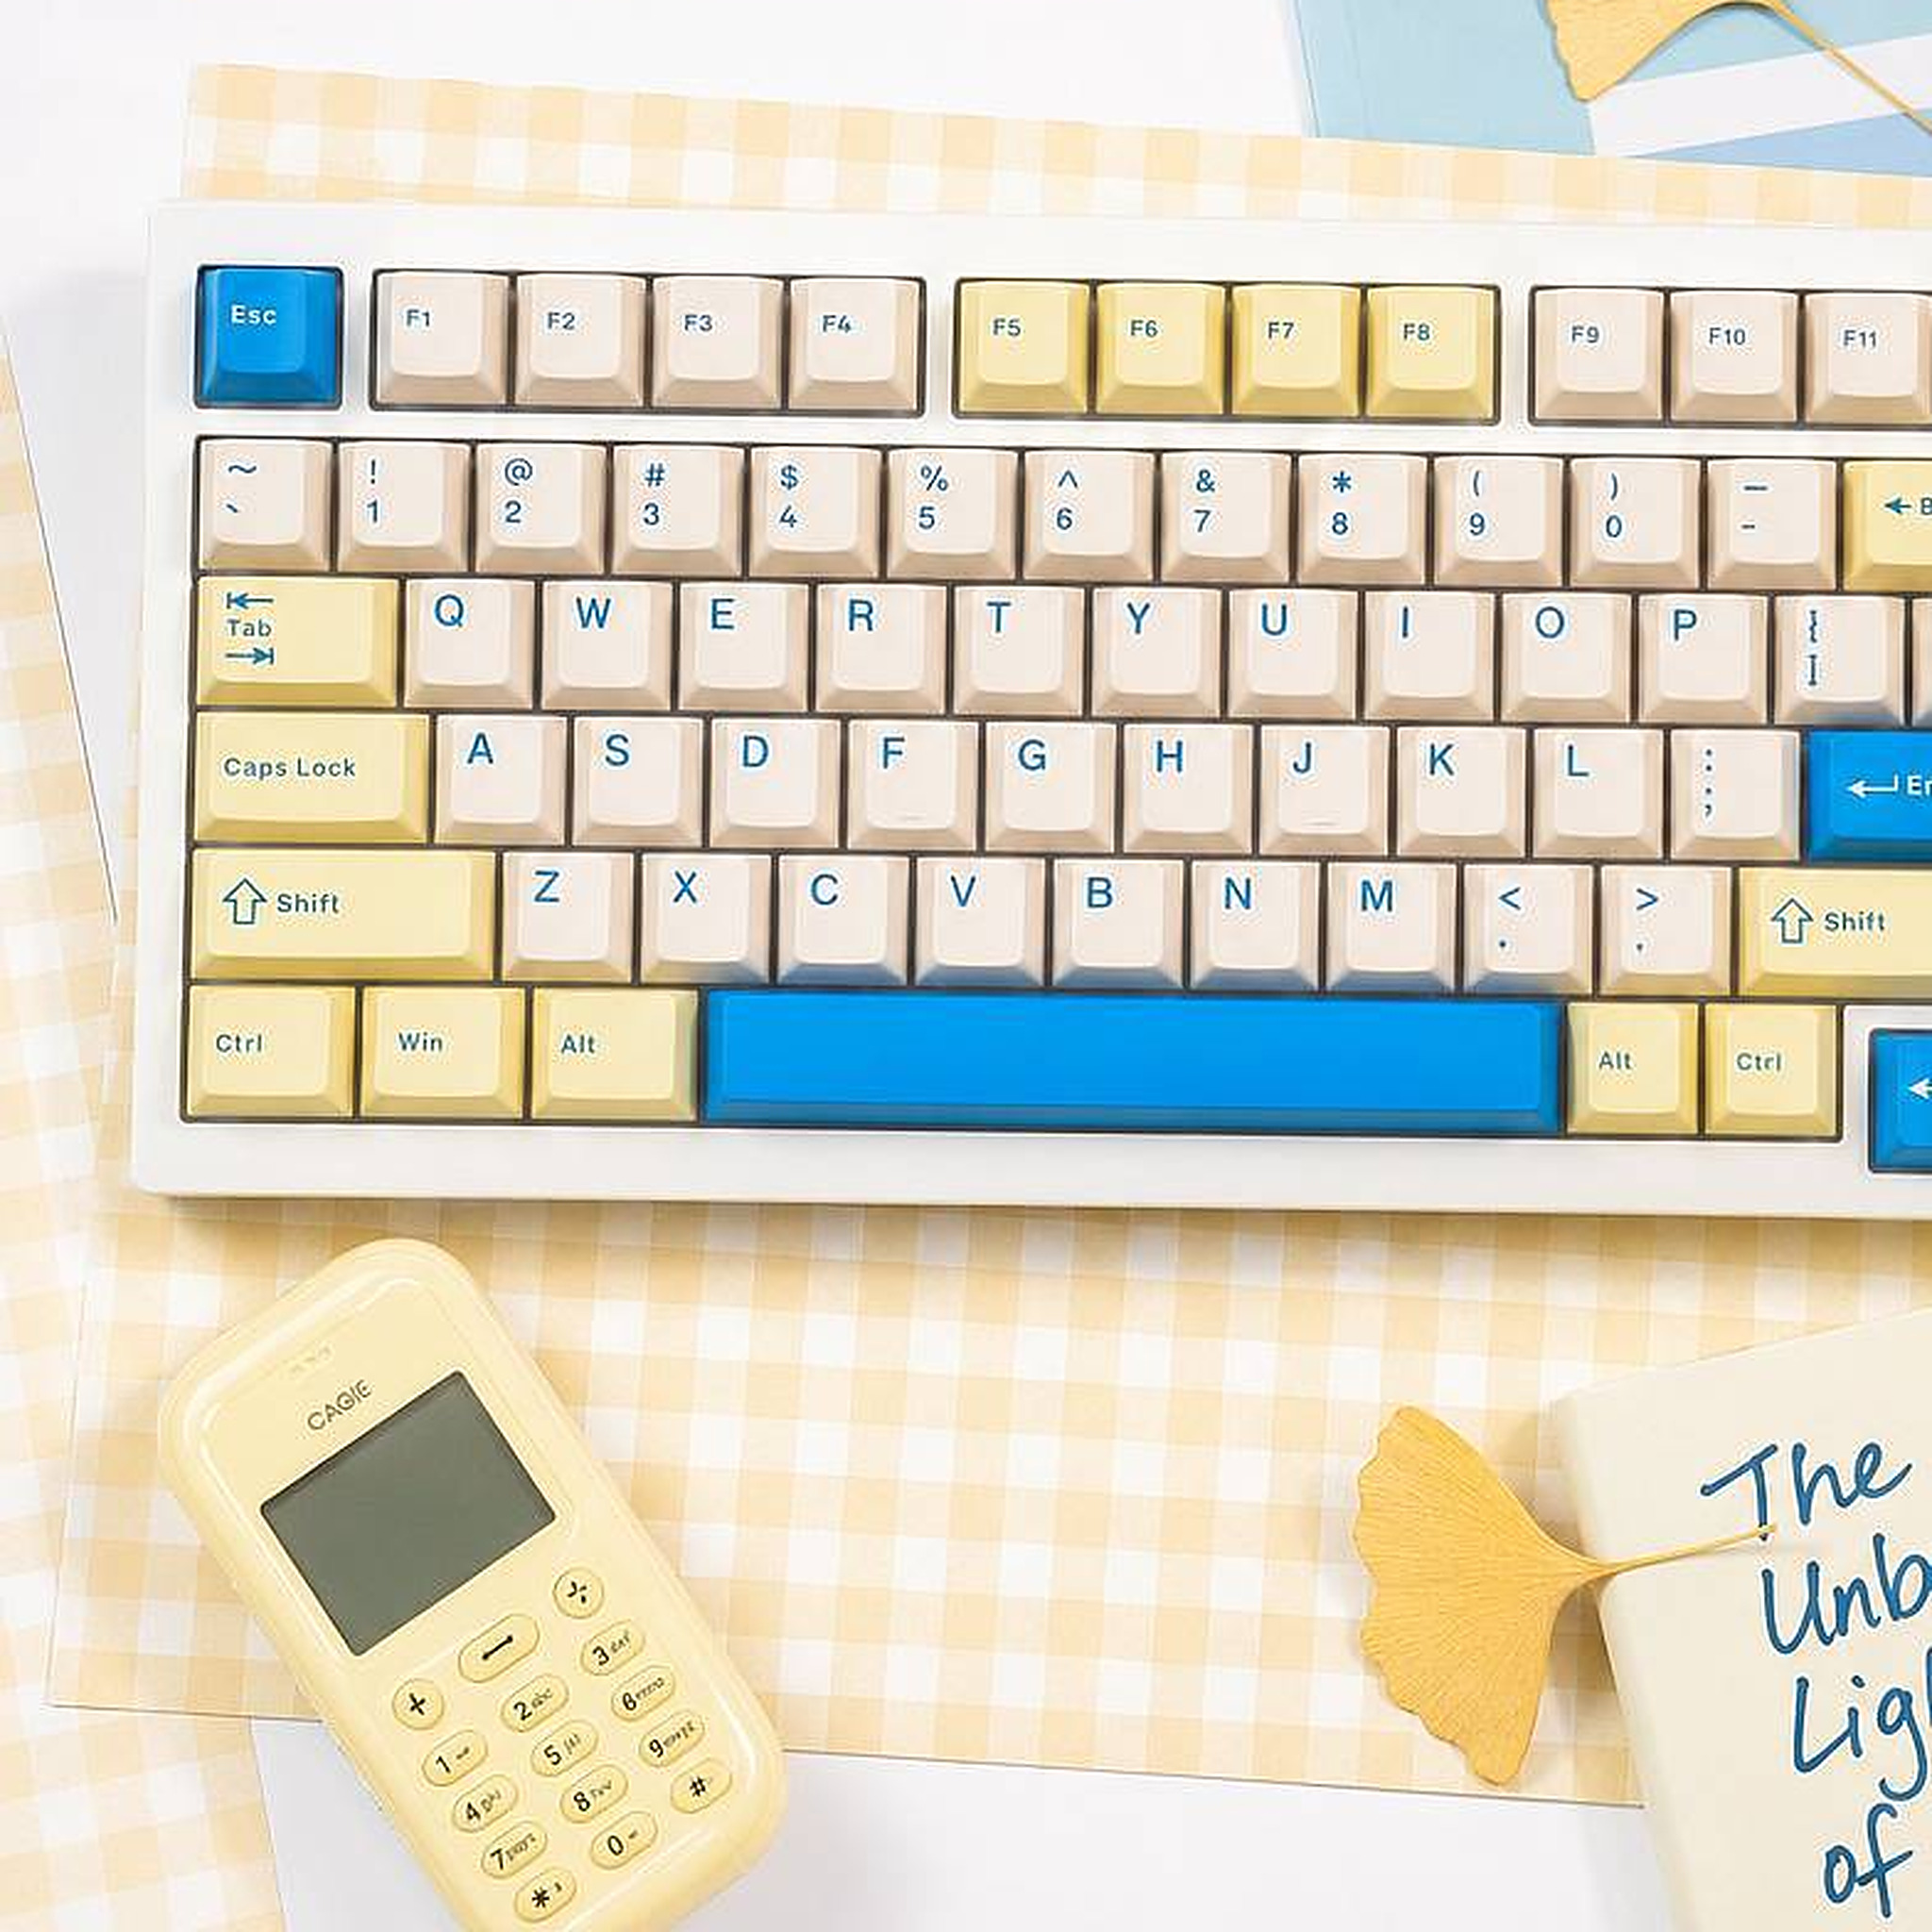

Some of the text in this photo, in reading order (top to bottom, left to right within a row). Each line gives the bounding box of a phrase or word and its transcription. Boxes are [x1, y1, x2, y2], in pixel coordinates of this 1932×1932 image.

[231, 305, 276, 325] Esc
[407, 308, 430, 327] F1
[548, 311, 575, 330] F2
[684, 314, 713, 332] F3
[823, 314, 851, 333] F4
[993, 318, 1022, 337] F5
[1130, 319, 1158, 338] F6
[1268, 321, 1294, 340] F7
[1403, 323, 1430, 341] F8
[1572, 325, 1600, 344] F9
[1708, 326, 1746, 346] F10
[1843, 329, 1876, 347] F11
[371, 459, 376, 485] !
[504, 458, 533, 487] @
[644, 463, 665, 488] #
[780, 464, 798, 491] $
[921, 465, 948, 491] %
[1196, 469, 1215, 493] &
[367, 500, 378, 523] 1
[505, 500, 522, 524] 2
[643, 503, 659, 525] 3
[779, 505, 798, 528] 4
[919, 506, 936, 530] 5
[1057, 508, 1073, 531] 6
[1193, 508, 1211, 533] 7
[1331, 511, 1349, 536] 8
[1470, 512, 1485, 536] 9
[1606, 515, 1623, 539] 0
[434, 593, 464, 627] Q
[575, 596, 611, 629] W
[711, 598, 735, 630] E
[849, 599, 874, 632] R
[987, 601, 1011, 633] T
[1126, 602, 1151, 635] Y
[1261, 604, 1288, 636] U
[227, 619, 272, 637] Tab
[1402, 606, 1408, 639] I
[1535, 606, 1565, 639] O
[1674, 608, 1697, 641] P
[467, 732, 494, 764] A
[605, 734, 629, 767] S
[742, 735, 769, 768] D
[883, 737, 906, 770] F
[1018, 739, 1046, 772] G
[1157, 740, 1183, 773] H
[1292, 741, 1312, 774] J
[1429, 743, 1454, 775] K
[224, 758, 356, 781] Caps Lock
[1568, 744, 1589, 777] L
[534, 870, 559, 903] Z
[673, 871, 697, 904] X
[811, 874, 838, 906] C
[950, 874, 976, 908] V
[1088, 876, 1113, 908] B
[1224, 877, 1251, 910] N
[1361, 880, 1393, 912] M
[1498, 887, 1521, 910] <
[276, 893, 339, 914] Shift
[1636, 888, 1658, 910] >
[1824, 910, 1885, 932] Shift
[216, 1034, 262, 1053] Ctrl
[398, 1032, 442, 1051] Win
[560, 1034, 595, 1054] Alt
[1598, 1051, 1631, 1070] Alt
[1737, 1053, 1781, 1071] Ctrl
[1700, 1441, 1912, 1541] The
[591, 1645, 609, 1666] 3
[513, 1701, 532, 1721] 2
[622, 1691, 638, 1711] 6
[1792, 1646, 1932, 1803] Lig
[543, 1744, 562, 1766] 5
[648, 1739, 664, 1758] 9
[435, 1756, 451, 1774] 1
[465, 1801, 480, 1821] 4
[573, 1790, 591, 1812] 8
[607, 1835, 625, 1857] 0
[489, 1848, 504, 1871] 7
[1823, 1803, 1914, 1919] of
